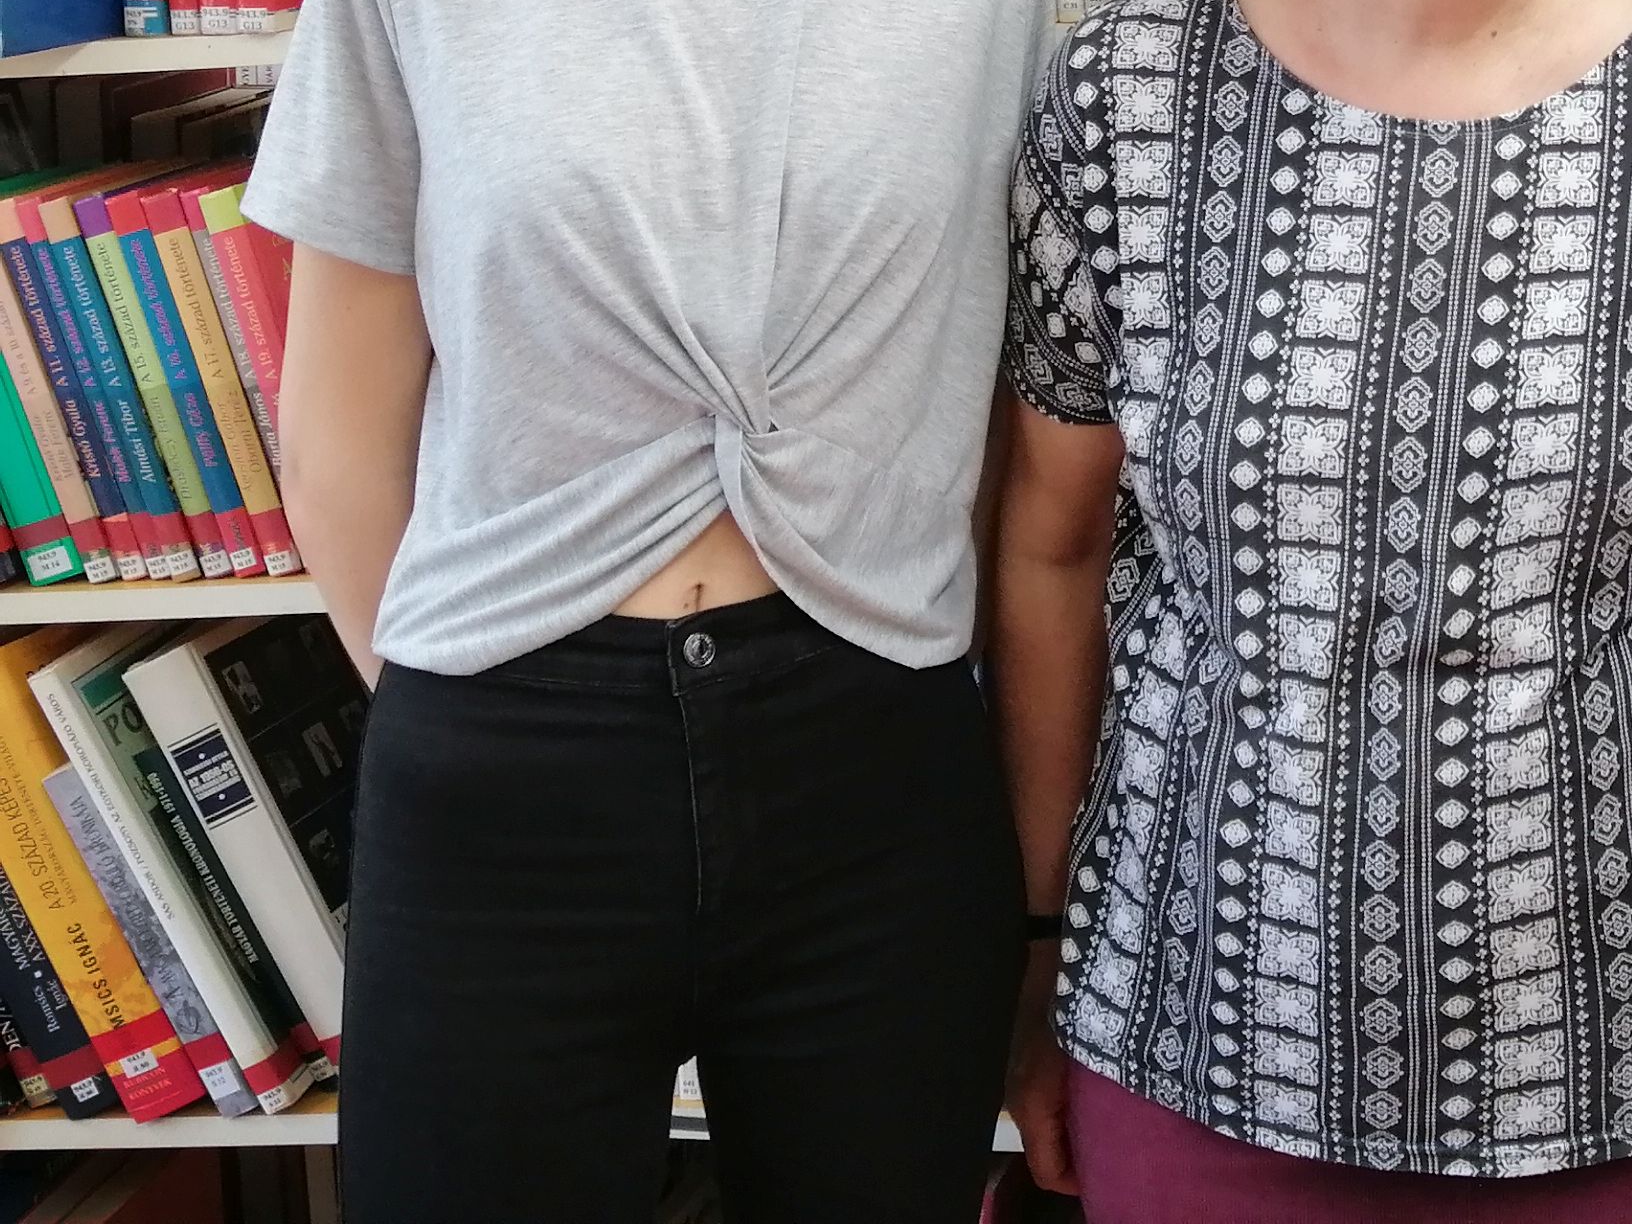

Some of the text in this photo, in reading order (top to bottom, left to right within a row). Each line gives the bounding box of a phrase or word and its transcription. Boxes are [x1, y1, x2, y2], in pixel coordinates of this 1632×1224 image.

[208, 19, 228, 28] G13
[10, 245, 57, 353] század története
[63, 246, 109, 354] század története
[188, 300, 213, 346] század
[242, 300, 266, 346] század
[118, 400, 138, 436] Tibor
[12, 821, 48, 878] SZÁZAD
[67, 922, 101, 975] IGNÁC
